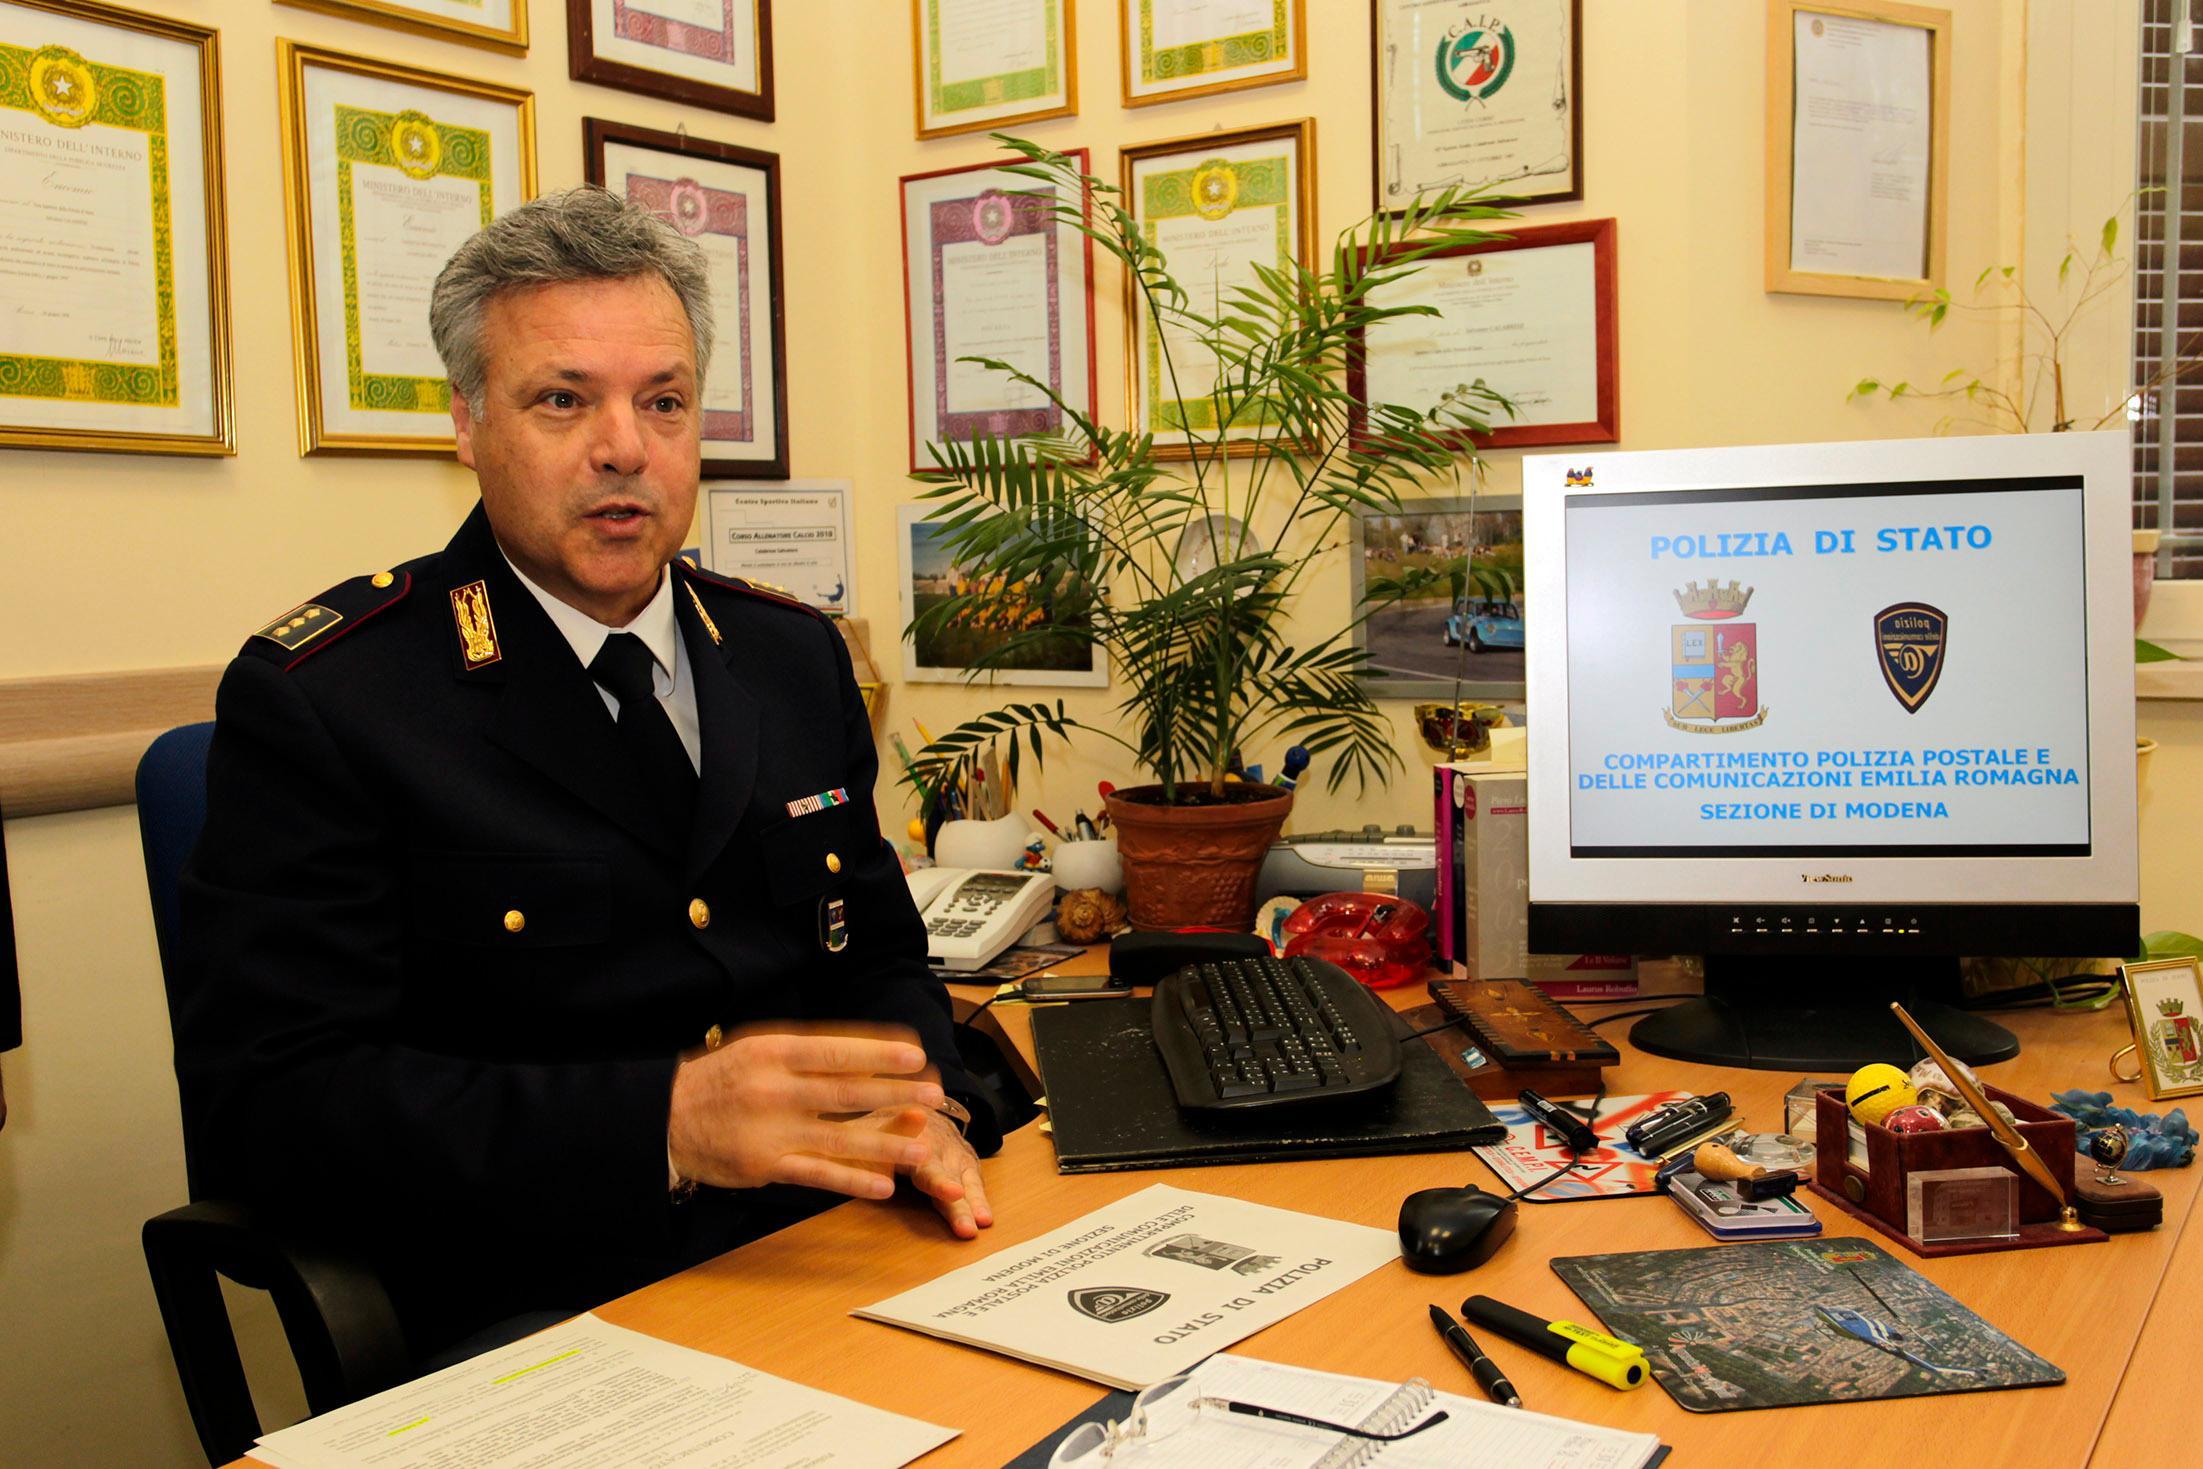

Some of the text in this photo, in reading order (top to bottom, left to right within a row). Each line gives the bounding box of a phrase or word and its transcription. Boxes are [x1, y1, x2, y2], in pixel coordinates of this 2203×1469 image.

[57, 138, 143, 162] DELL'INTERNO
[760, 498, 789, 506] Sportivo
[1650, 524, 1993, 560] POLIZIA DI STATO
[1604, 748, 2050, 770] COMPARTIMENTO POLIZIA POSTALE E
[1578, 768, 2080, 790] DELLE COMUNICAZIONI EMILIA ROMAGNA
[1700, 801, 1950, 820] SEZIONE DI MODENA
[1092, 1214, 1195, 1260] COMPARTIMENTO
[934, 1205, 1194, 1319] DELLE COMUNICAZIONI EMILIA ROMAGNA
[982, 1225, 1115, 1283] SEZIONE DI MODENA
[1039, 1258, 1095, 1285] POLIZIA
[978, 1283, 1039, 1313] POSTALE
[1154, 1257, 1333, 1345] POLIZIA DI STATO
